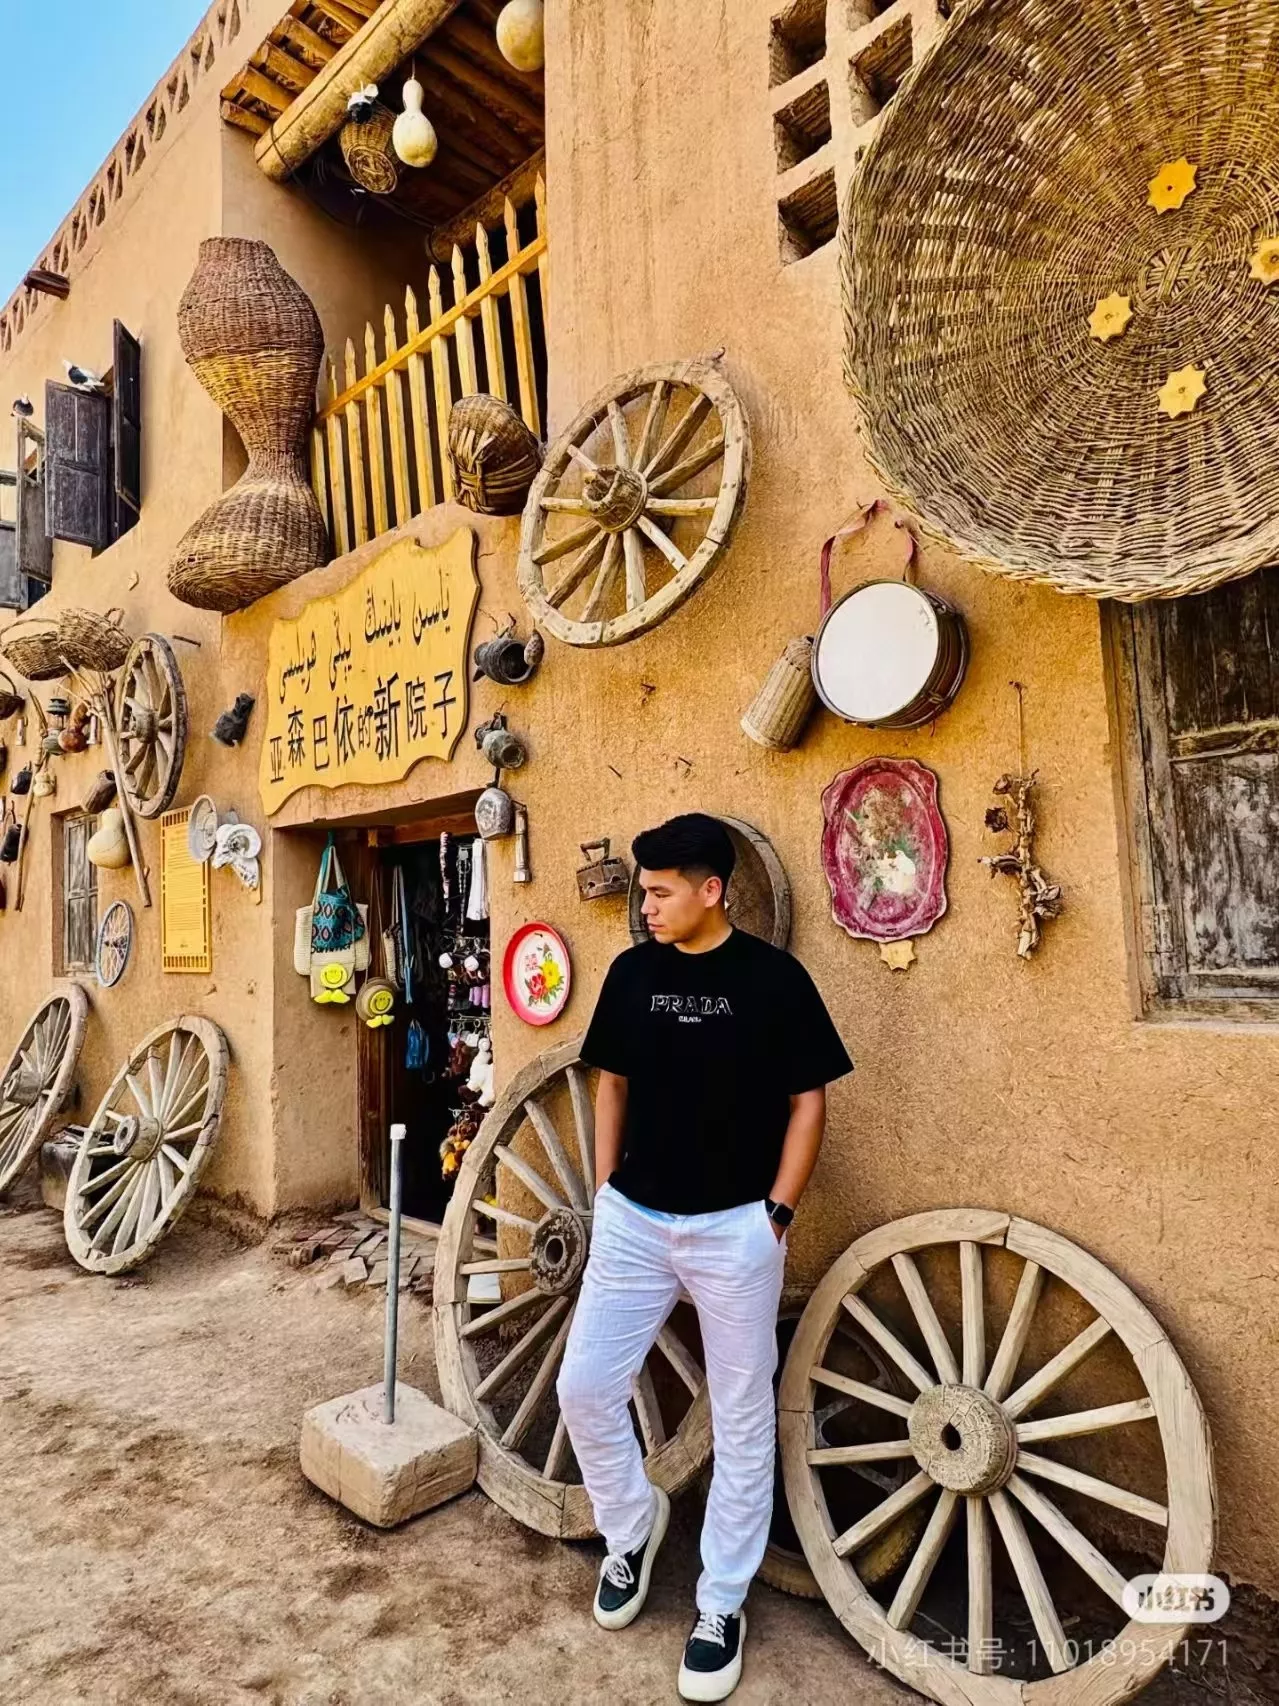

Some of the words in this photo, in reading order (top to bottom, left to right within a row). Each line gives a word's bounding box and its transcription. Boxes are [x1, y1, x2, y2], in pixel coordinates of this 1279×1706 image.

[269, 671, 457, 784] 亚森巴依的新院子
[650, 994, 733, 1015] PRADA
